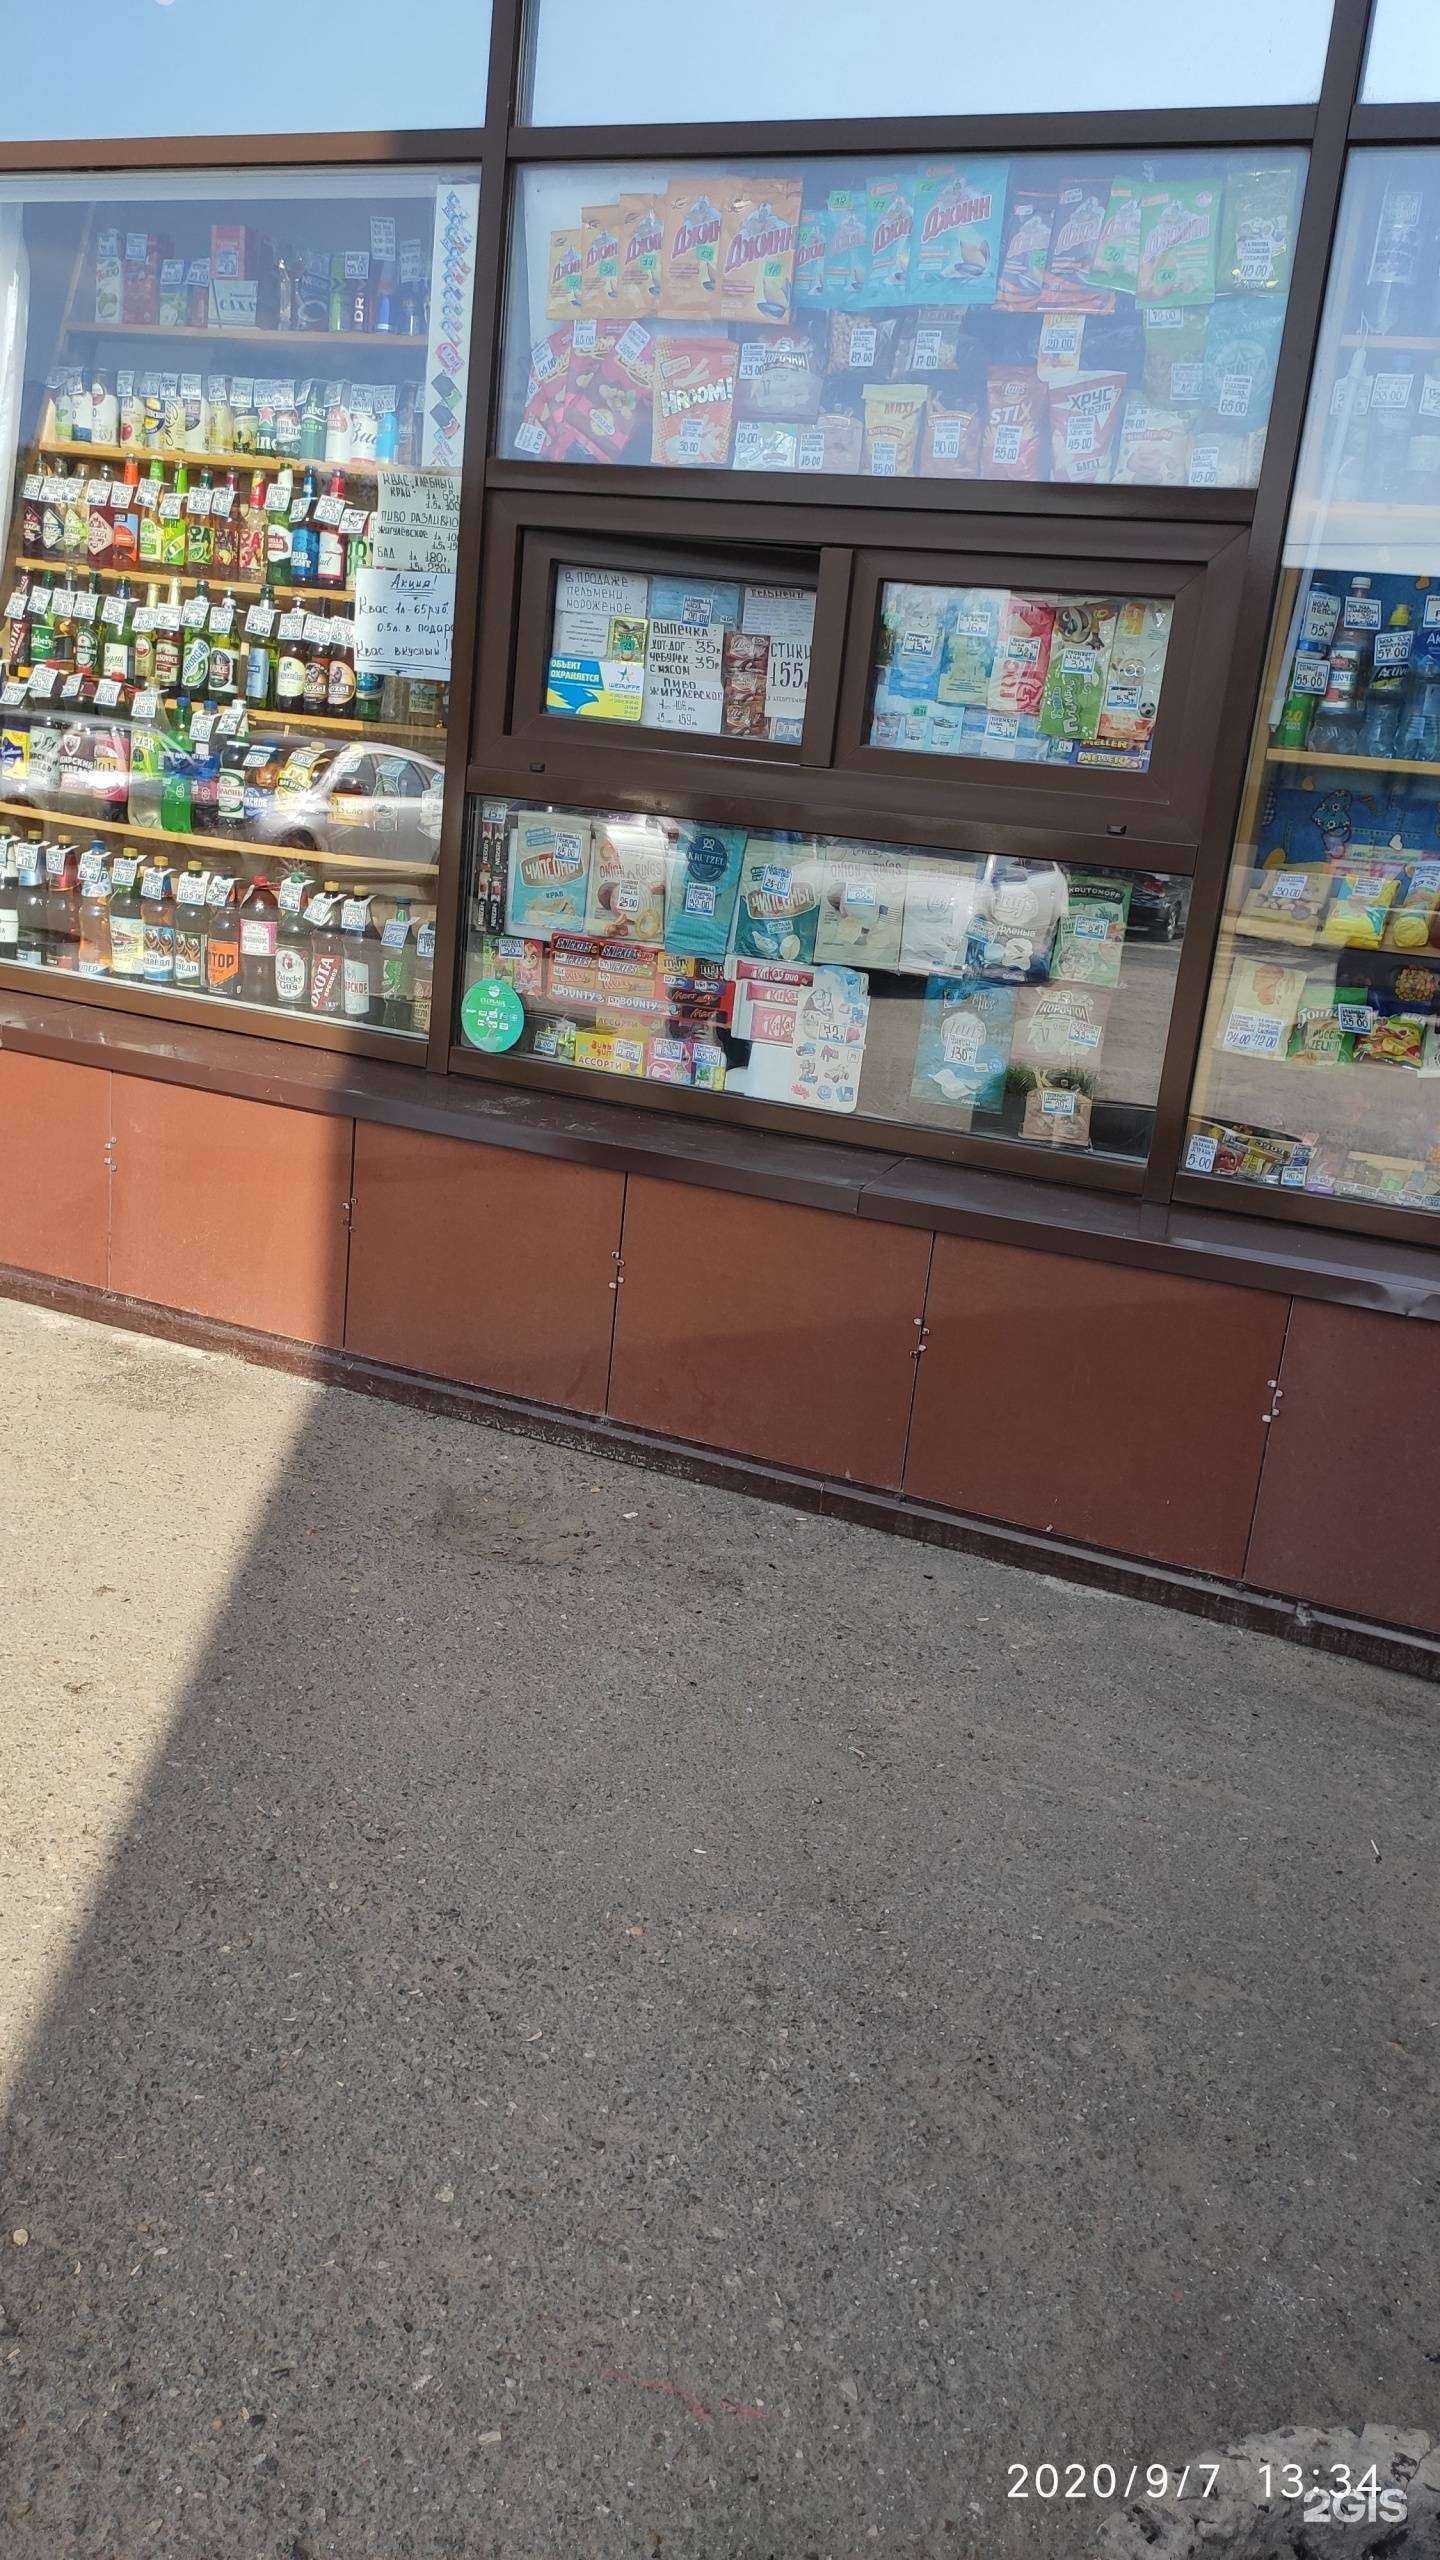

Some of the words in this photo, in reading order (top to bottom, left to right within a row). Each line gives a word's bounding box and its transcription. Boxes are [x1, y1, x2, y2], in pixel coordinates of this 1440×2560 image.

[671, 219, 721, 261] ДЖИН
[764, 351, 807, 370] ОРОЧКИ
[359, 594, 389, 615] Квас
[355, 639, 385, 658] Квас
[566, 953, 592, 968] ICKERS
